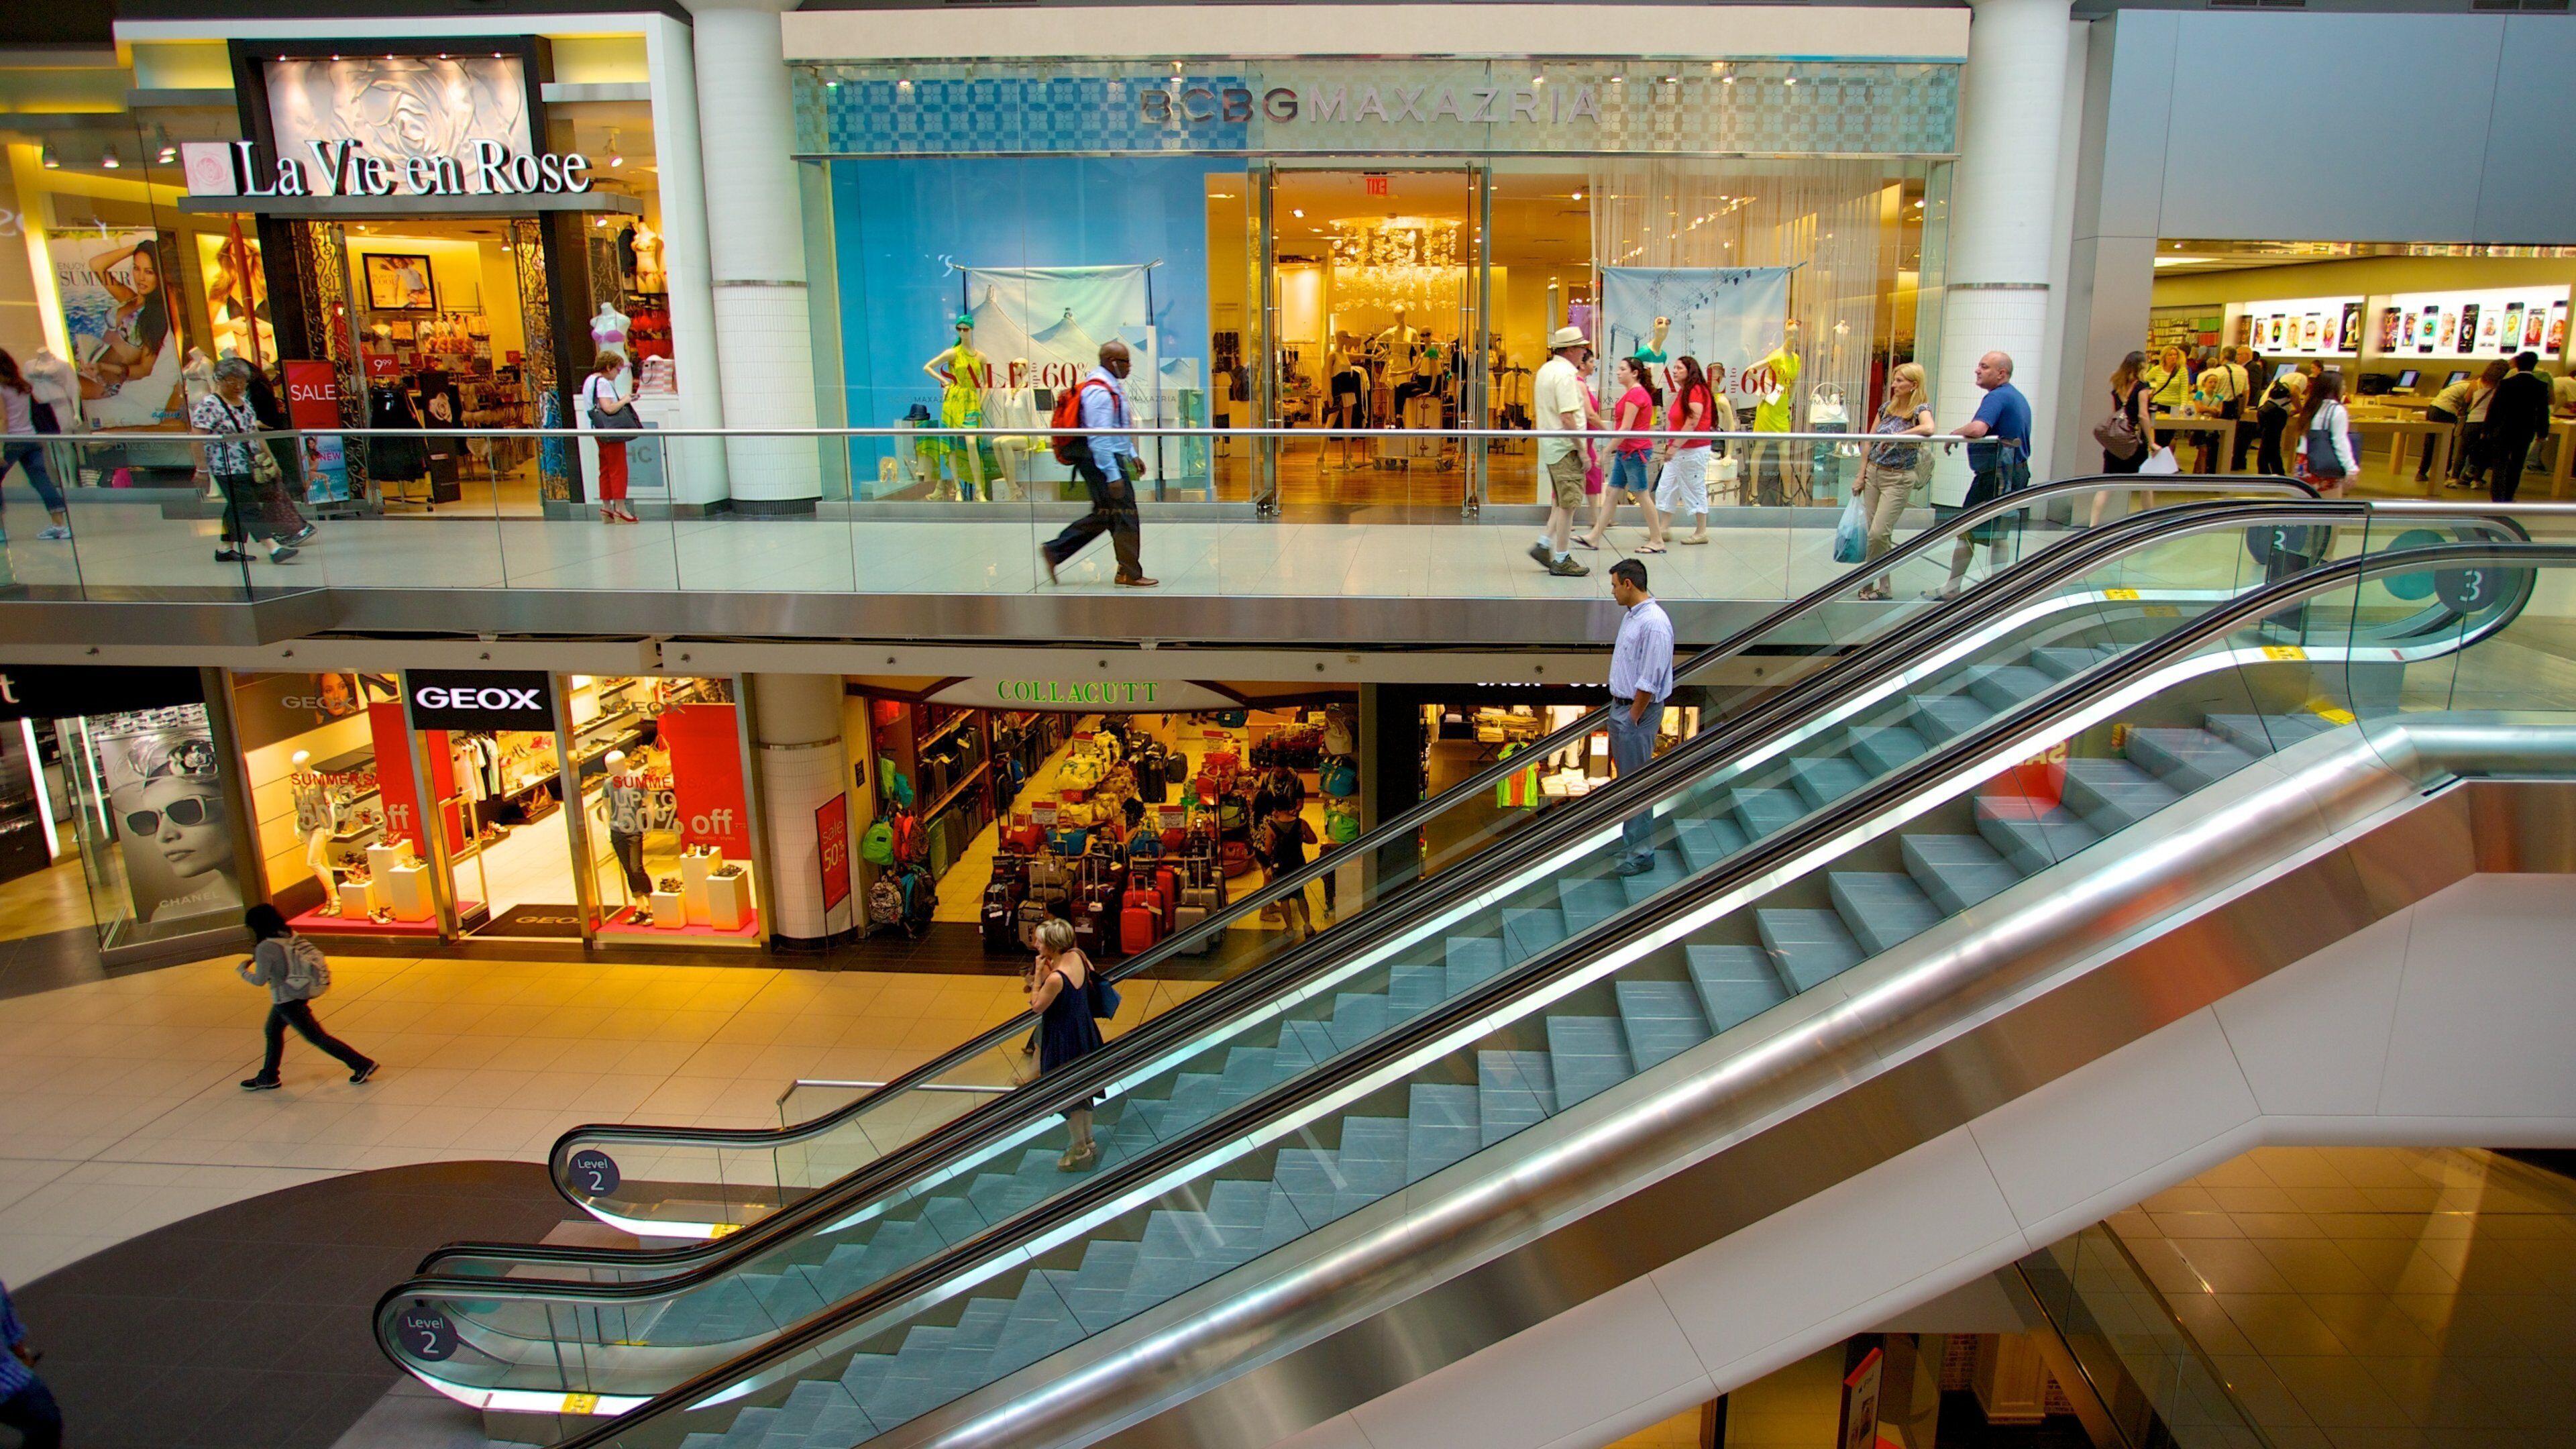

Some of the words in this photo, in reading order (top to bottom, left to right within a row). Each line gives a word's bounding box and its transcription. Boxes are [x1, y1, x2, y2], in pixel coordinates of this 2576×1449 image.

[1141, 88, 1297, 123] BCBG
[1310, 88, 1602, 123] MAXAZRIA
[237, 141, 307, 195] La
[305, 138, 396, 195] Vie
[406, 155, 466, 195] en
[470, 138, 591, 194] Rose
[60, 271, 131, 286] SUMMER
[941, 362, 1028, 388] SALE
[290, 384, 337, 400] SALE
[320, 451, 347, 462] NEW
[2459, 570, 2482, 602] 3
[416, 687, 542, 710] GEOX
[998, 680, 1159, 703] COLLACUTT
[282, 696, 354, 712] GEOX
[611, 702, 686, 714] GEOX
[291, 773, 360, 786] SUMMER
[613, 775, 683, 789] SUMMER
[614, 792, 642, 807] UP
[370, 804, 409, 830] off
[618, 807, 685, 835] 50%
[691, 809, 733, 835] off
[822, 820, 844, 845] sale
[160, 891, 220, 908] CHANEL
[578, 1159, 608, 1169] Level
[589, 1171, 604, 1191] 2
[408, 1316, 443, 1329] Level
[421, 1330, 439, 1354] 2
